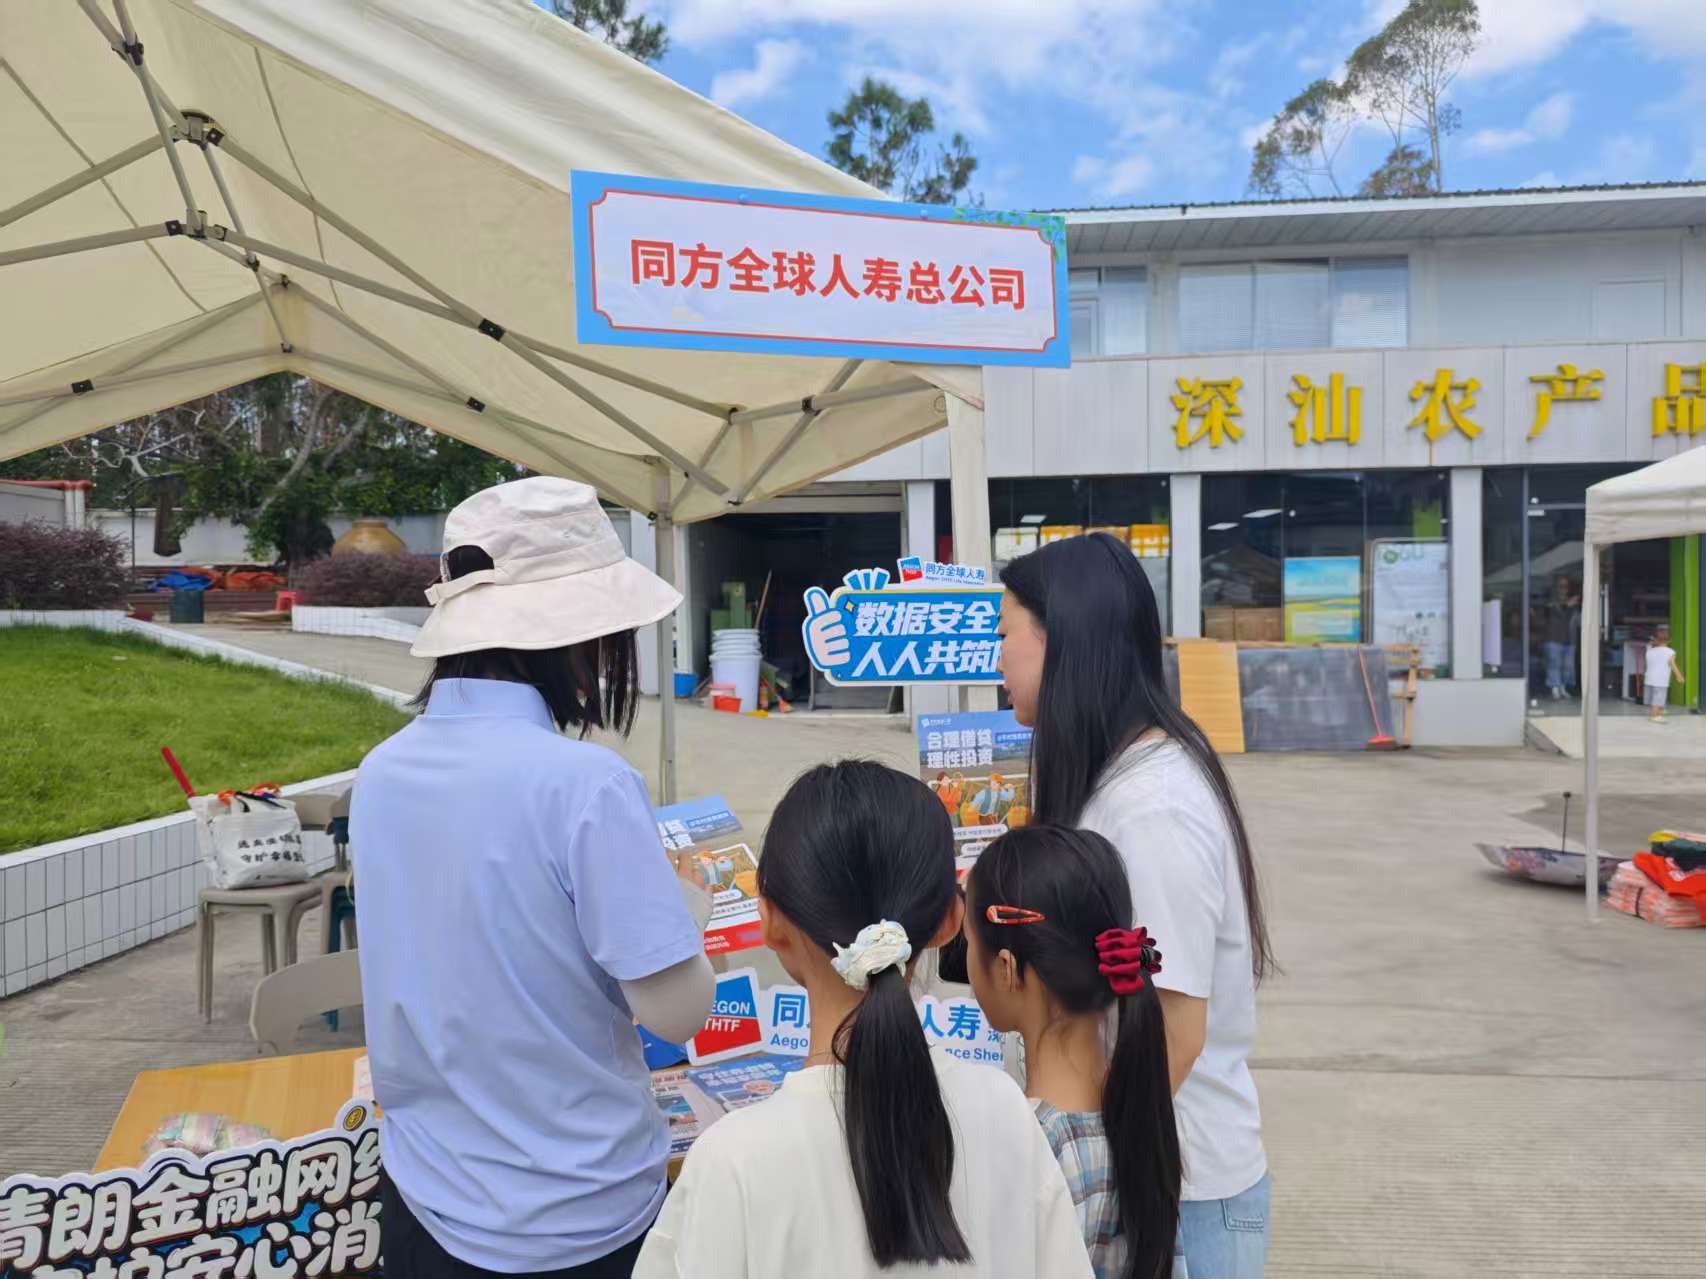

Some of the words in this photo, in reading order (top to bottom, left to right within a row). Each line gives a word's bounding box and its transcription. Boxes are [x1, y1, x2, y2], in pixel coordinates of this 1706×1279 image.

[630, 239, 1026, 310] 同方全球人寿总公司
[1171, 363, 1706, 449] 深汕农产品
[852, 601, 1003, 637] 数据安全
[851, 640, 1003, 678] 人人共筑
[711, 1000, 750, 1015] EGON
[772, 993, 812, 1028] 同
[922, 1004, 981, 1040] 人寿
[770, 1033, 809, 1050] Aego
